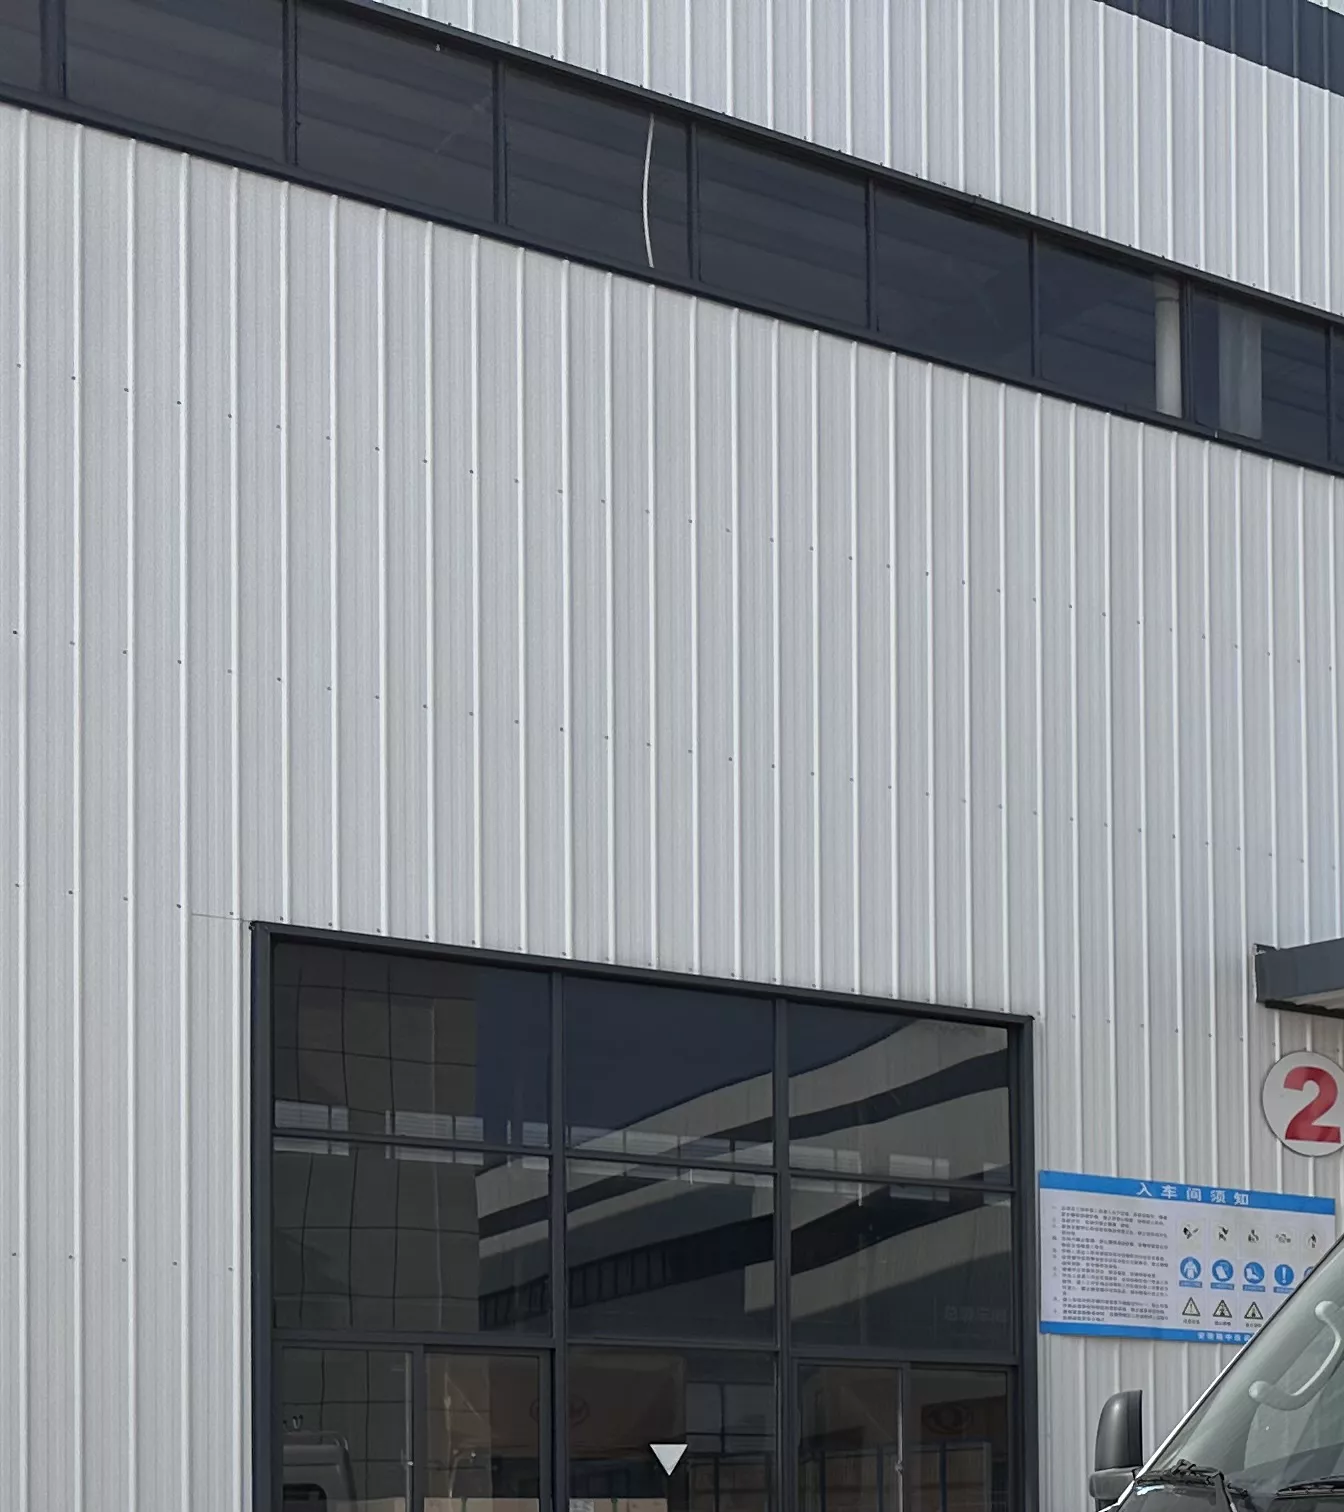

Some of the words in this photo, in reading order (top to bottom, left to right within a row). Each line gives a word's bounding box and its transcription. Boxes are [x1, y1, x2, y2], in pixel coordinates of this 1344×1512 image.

[1283, 1066, 1341, 1143] 2
[1136, 1182, 1249, 1205] 入车间须知
